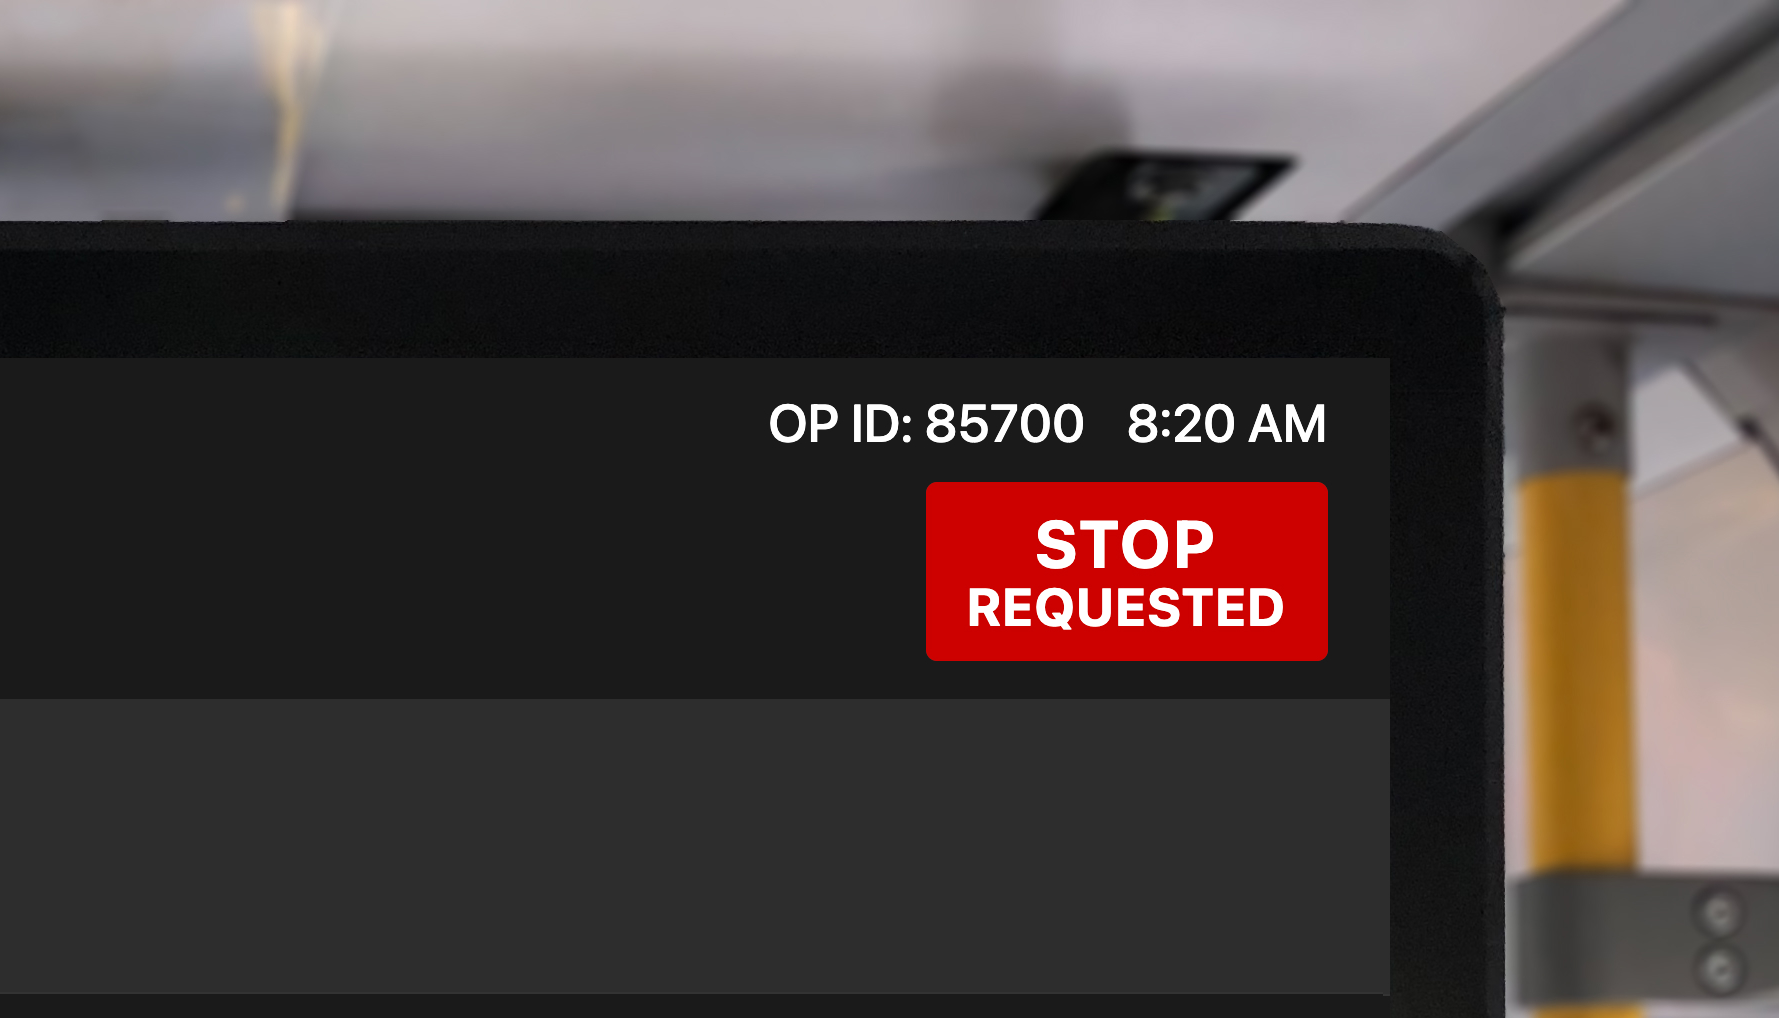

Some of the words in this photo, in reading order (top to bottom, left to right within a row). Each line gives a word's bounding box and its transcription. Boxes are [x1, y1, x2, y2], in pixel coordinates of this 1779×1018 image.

[770, 404, 838, 443] OP
[854, 404, 911, 443] ID:
[927, 404, 1083, 443] 85700
[1129, 404, 1234, 443] 8:20
[1248, 404, 1324, 442] AM
[1037, 520, 1213, 569] STOP
[970, 588, 1283, 630] REQUESTED
